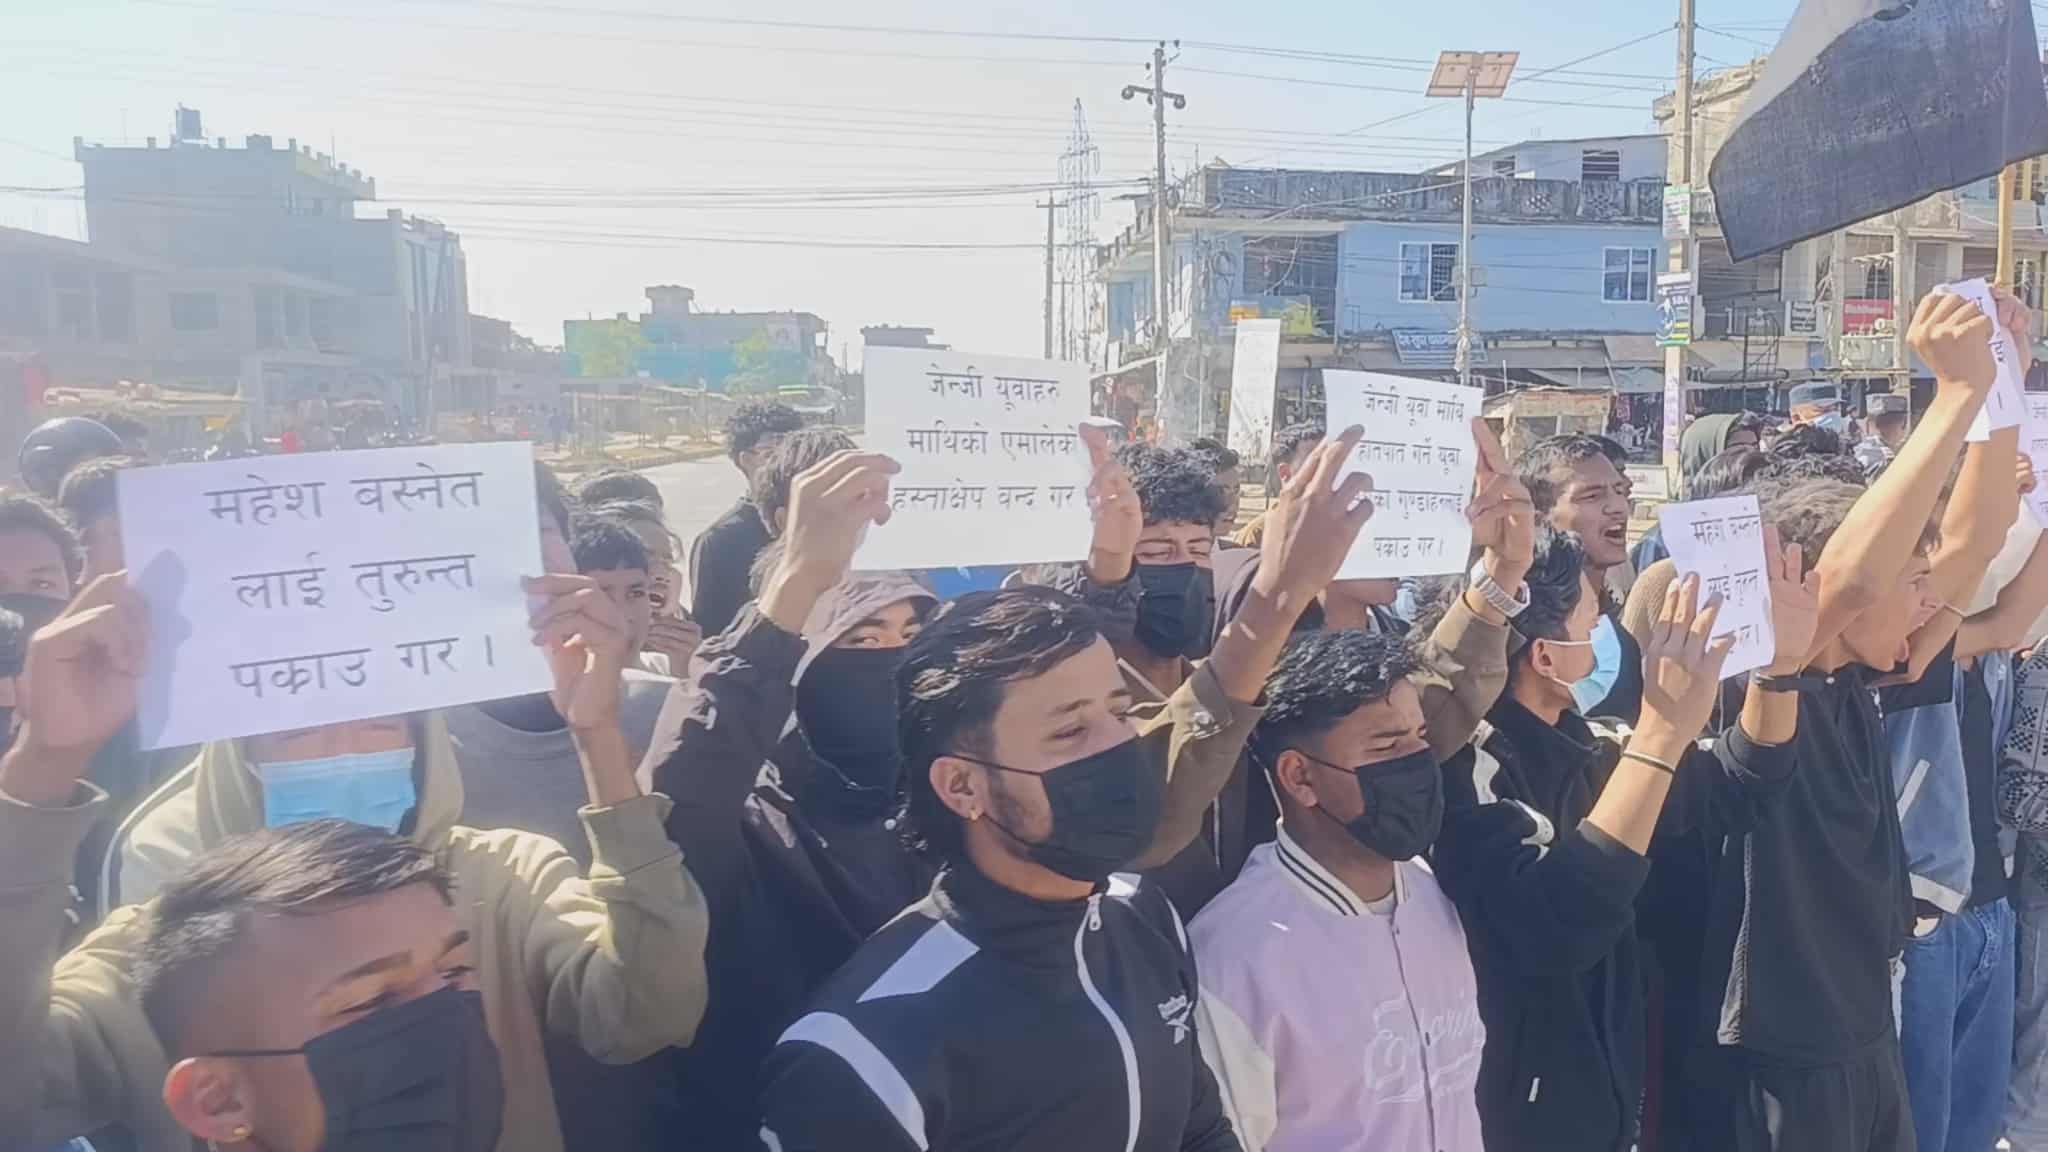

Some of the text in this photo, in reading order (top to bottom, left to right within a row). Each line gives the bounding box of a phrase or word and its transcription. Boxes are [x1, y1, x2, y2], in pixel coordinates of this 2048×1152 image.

[906, 419, 989, 455] माथिको
[203, 474, 326, 525] महेश
[231, 552, 476, 612] लाई तुरुन्त
[396, 637, 460, 676] गर
